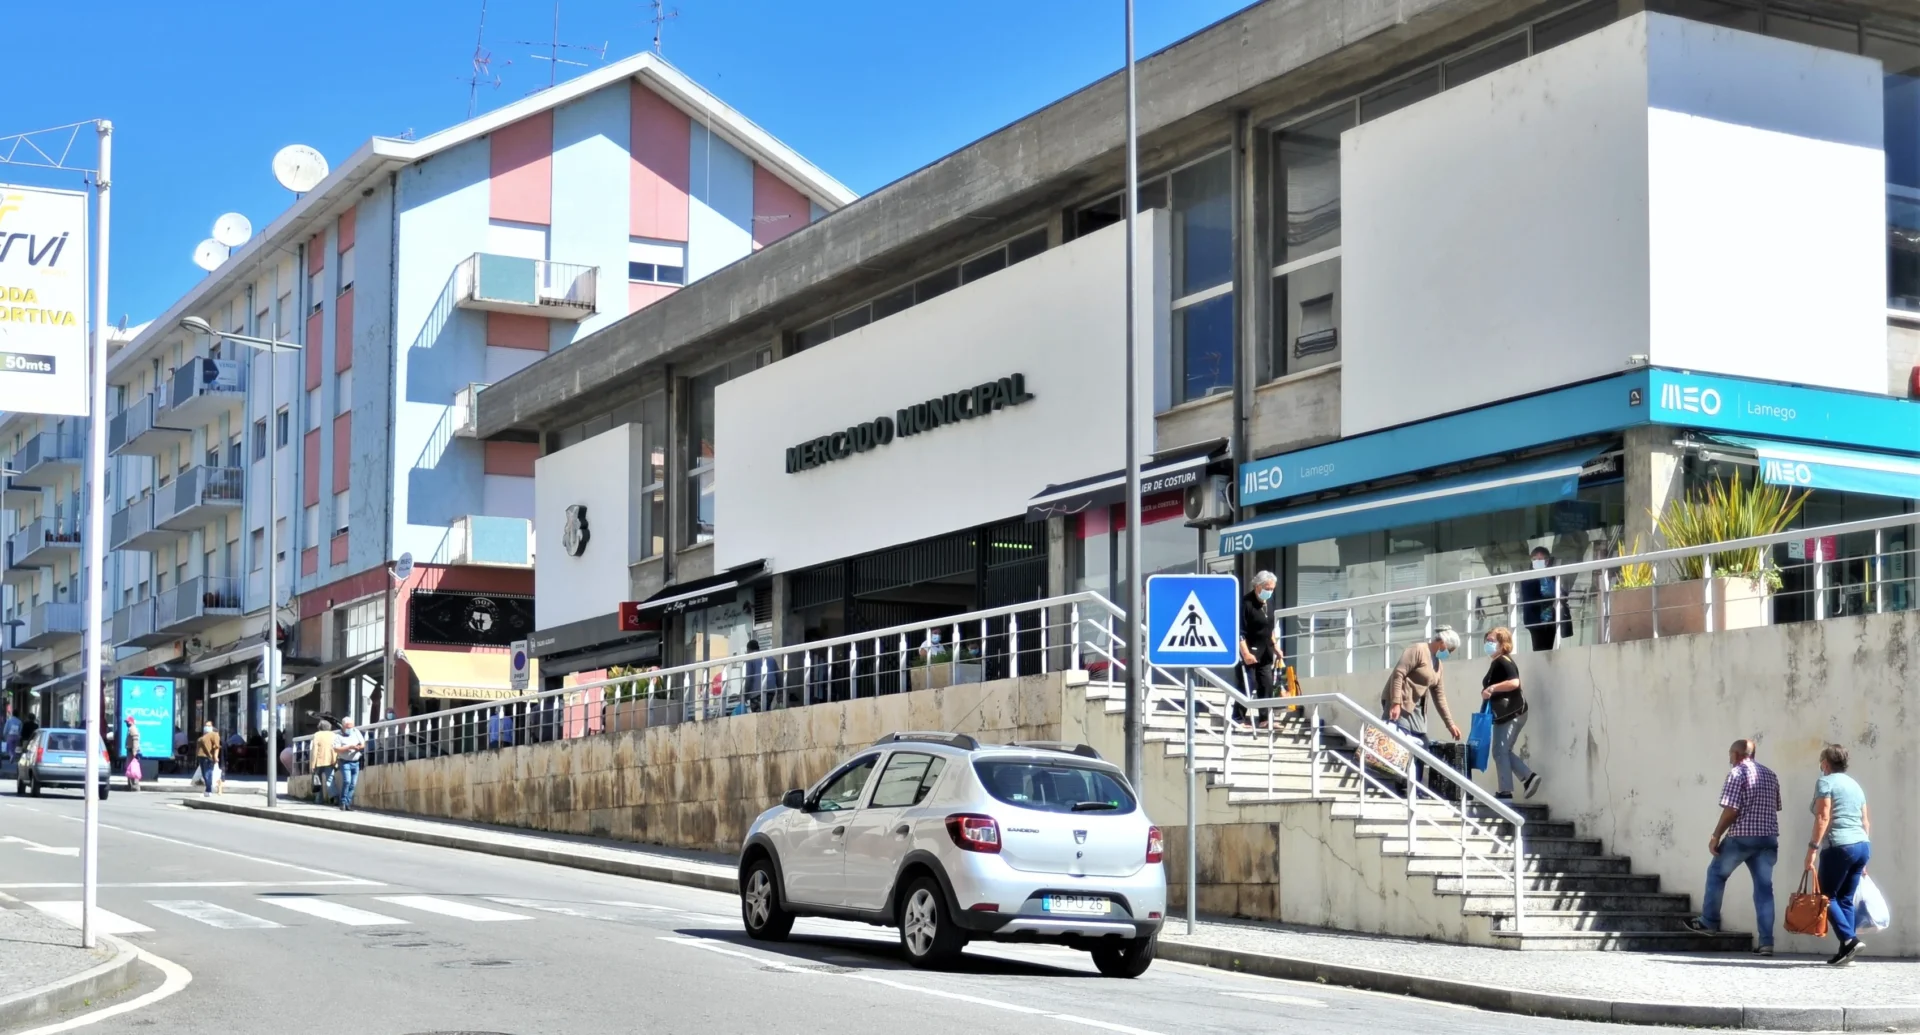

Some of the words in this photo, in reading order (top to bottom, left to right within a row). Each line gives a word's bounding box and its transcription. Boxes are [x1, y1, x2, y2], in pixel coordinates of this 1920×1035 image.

[5, 355, 51, 371] 50mts
[1661, 383, 1721, 415] MEO
[1747, 401, 1796, 421] Lamego
[786, 416, 894, 474] MERCADO
[896, 372, 1036, 438] MUNICIPAL
[1153, 479, 1163, 490] DE
[1164, 472, 1196, 488] COSTURA
[1244, 466, 1283, 494] MEO
[1300, 463, 1335, 478] Lamego
[1765, 461, 1812, 484] MEO
[1224, 533, 1254, 553] MEO
[442, 687, 492, 699] GALERIA
[495, 691, 517, 699] DOS
[1051, 895, 1062, 908] 18
[1089, 897, 1103, 910] 26
